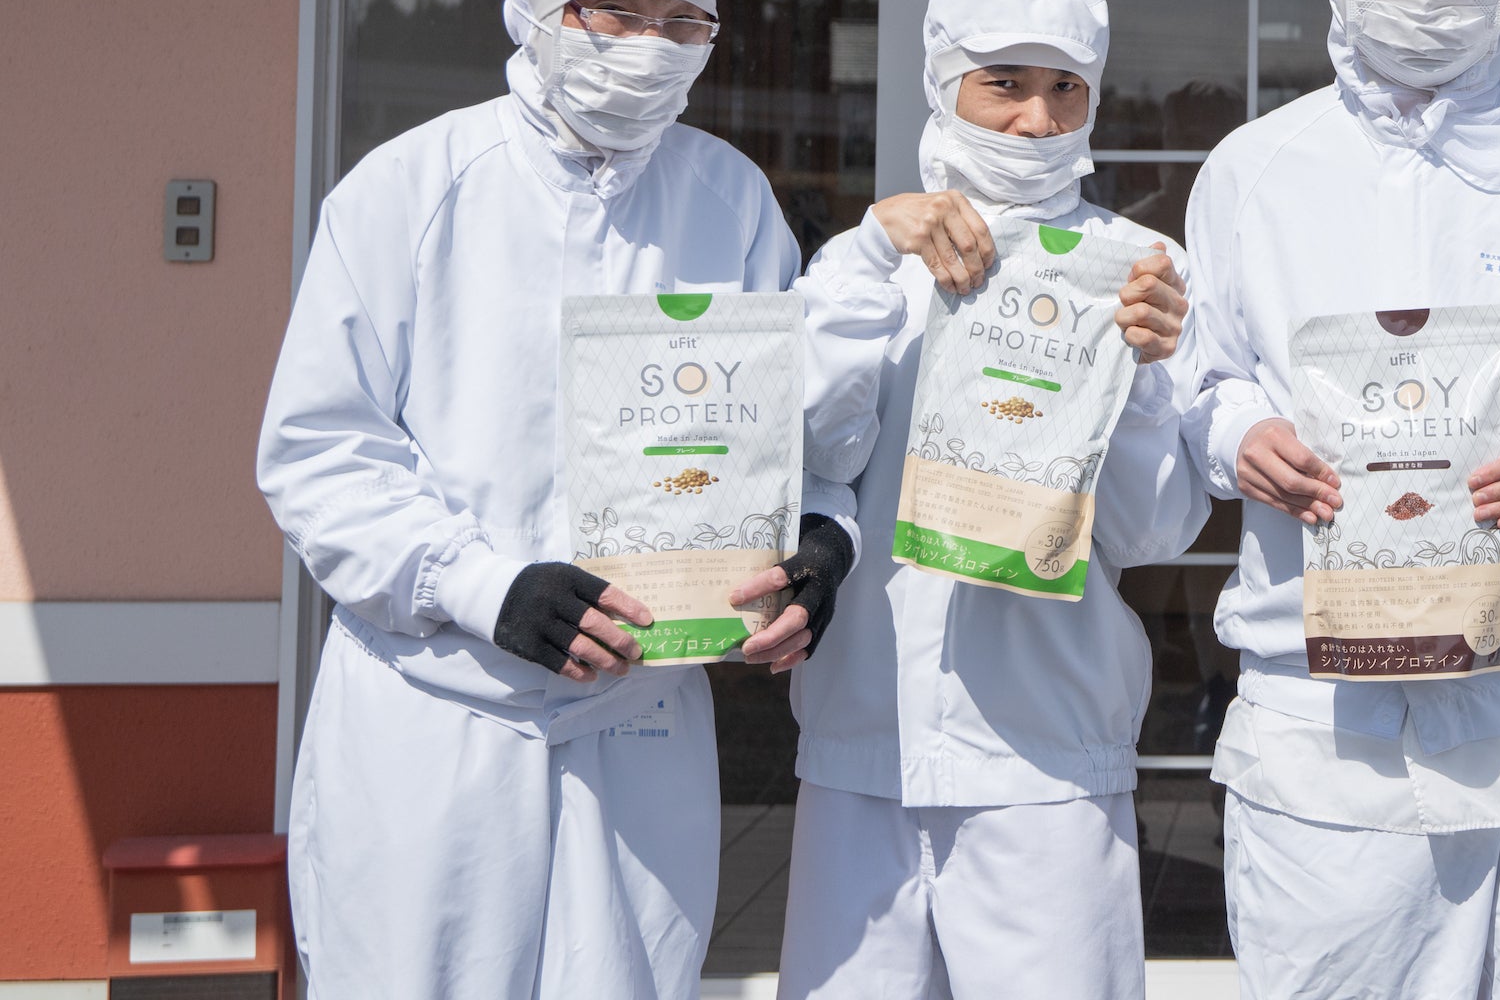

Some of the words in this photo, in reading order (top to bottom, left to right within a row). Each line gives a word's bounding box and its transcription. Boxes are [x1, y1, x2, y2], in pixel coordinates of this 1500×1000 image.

[1034, 268, 1059, 283] uFit
[998, 286, 1094, 333] SOY
[670, 337, 697, 349] uFit
[969, 321, 1098, 367] PROTEIN
[1390, 353, 1416, 366] uFit
[998, 359, 1017, 369] Made
[1019, 362, 1028, 371] in
[1030, 365, 1053, 377] Japan
[641, 361, 742, 397] SOY
[1362, 376, 1459, 413] SOY
[619, 403, 757, 427] PROTEIN
[1341, 416, 1477, 442] PROTEIN
[680, 434, 690, 442] in
[1377, 450, 1397, 458] Made
[1412, 449, 1437, 458] Japan
[1044, 534, 1064, 548] 30
[904, 541, 1019, 579] シプルソイプロテイン
[758, 595, 772, 609] 30
[1479, 609, 1495, 624] 30
[1320, 655, 1464, 670] シンプルソイプロテイン
